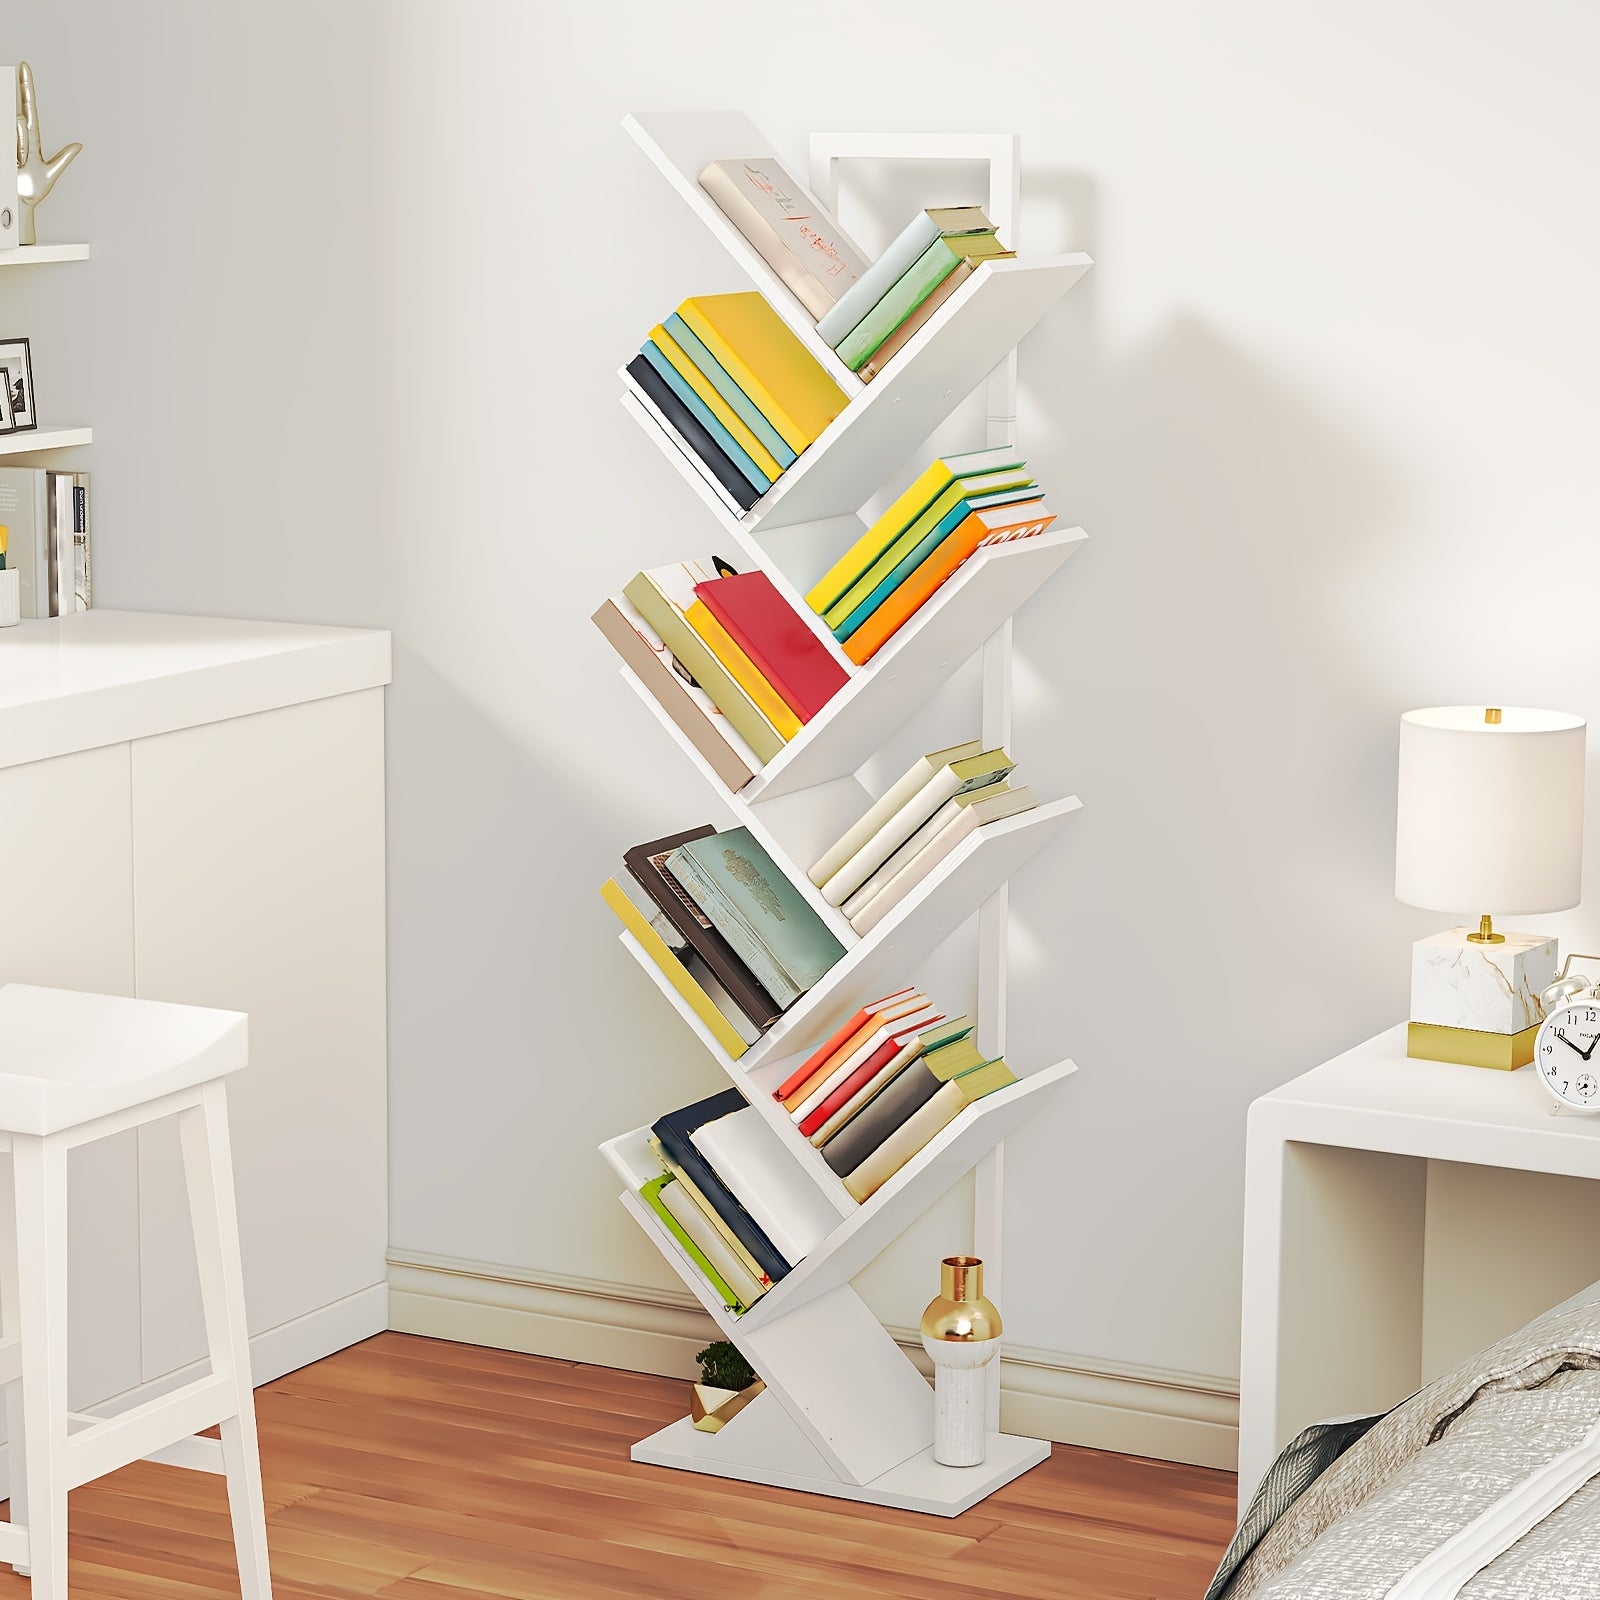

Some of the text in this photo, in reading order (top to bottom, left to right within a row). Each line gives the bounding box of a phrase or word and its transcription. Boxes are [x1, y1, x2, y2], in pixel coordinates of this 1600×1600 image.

[1567, 1014, 1577, 1025] 11
[1585, 1011, 1596, 1021] 12
[1546, 1045, 1553, 1055] 9
[1551, 1066, 1557, 1076] 8
[1563, 1080, 1569, 1092] 7
